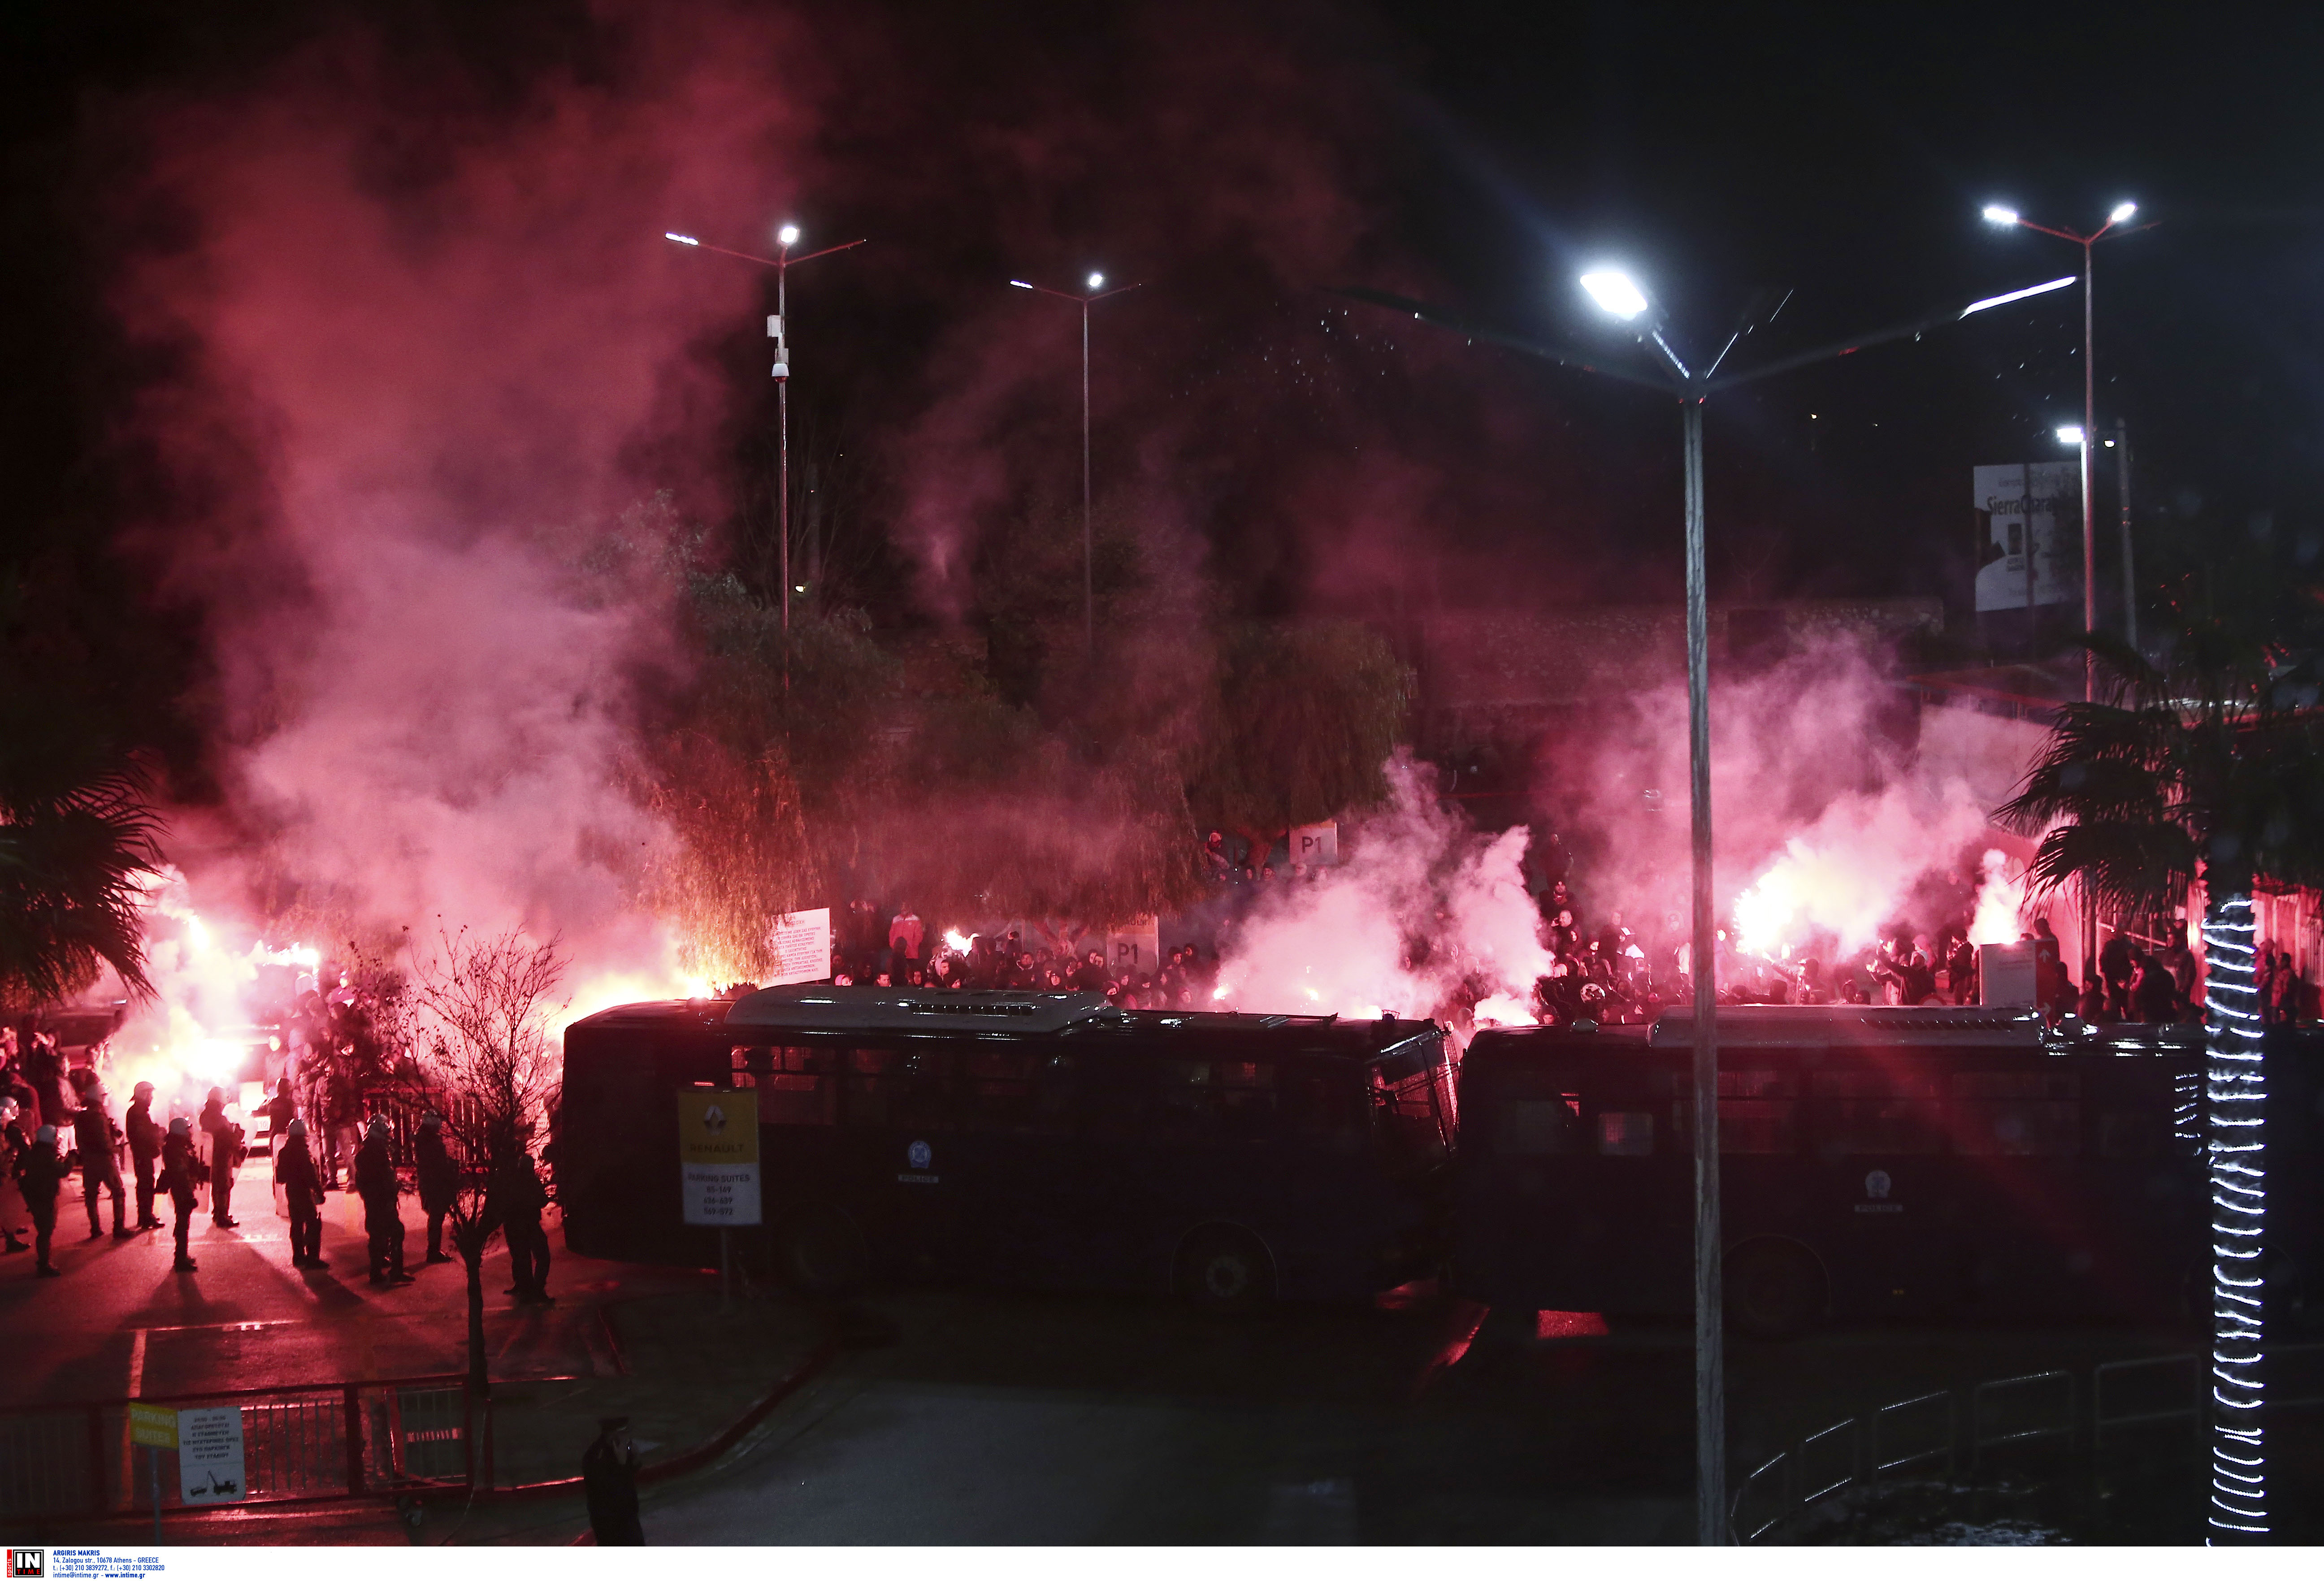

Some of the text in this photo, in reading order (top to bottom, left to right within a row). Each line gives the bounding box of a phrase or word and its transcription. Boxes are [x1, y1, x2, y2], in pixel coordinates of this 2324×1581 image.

[1302, 836, 1321, 853] P1
[1118, 943, 1138, 964] P1
[689, 1144, 744, 1153] RENAULT
[688, 1174, 750, 1183] PARKING SUITES
[132, 1410, 176, 1428] PARKING
[135, 1429, 170, 1444] SUITES
